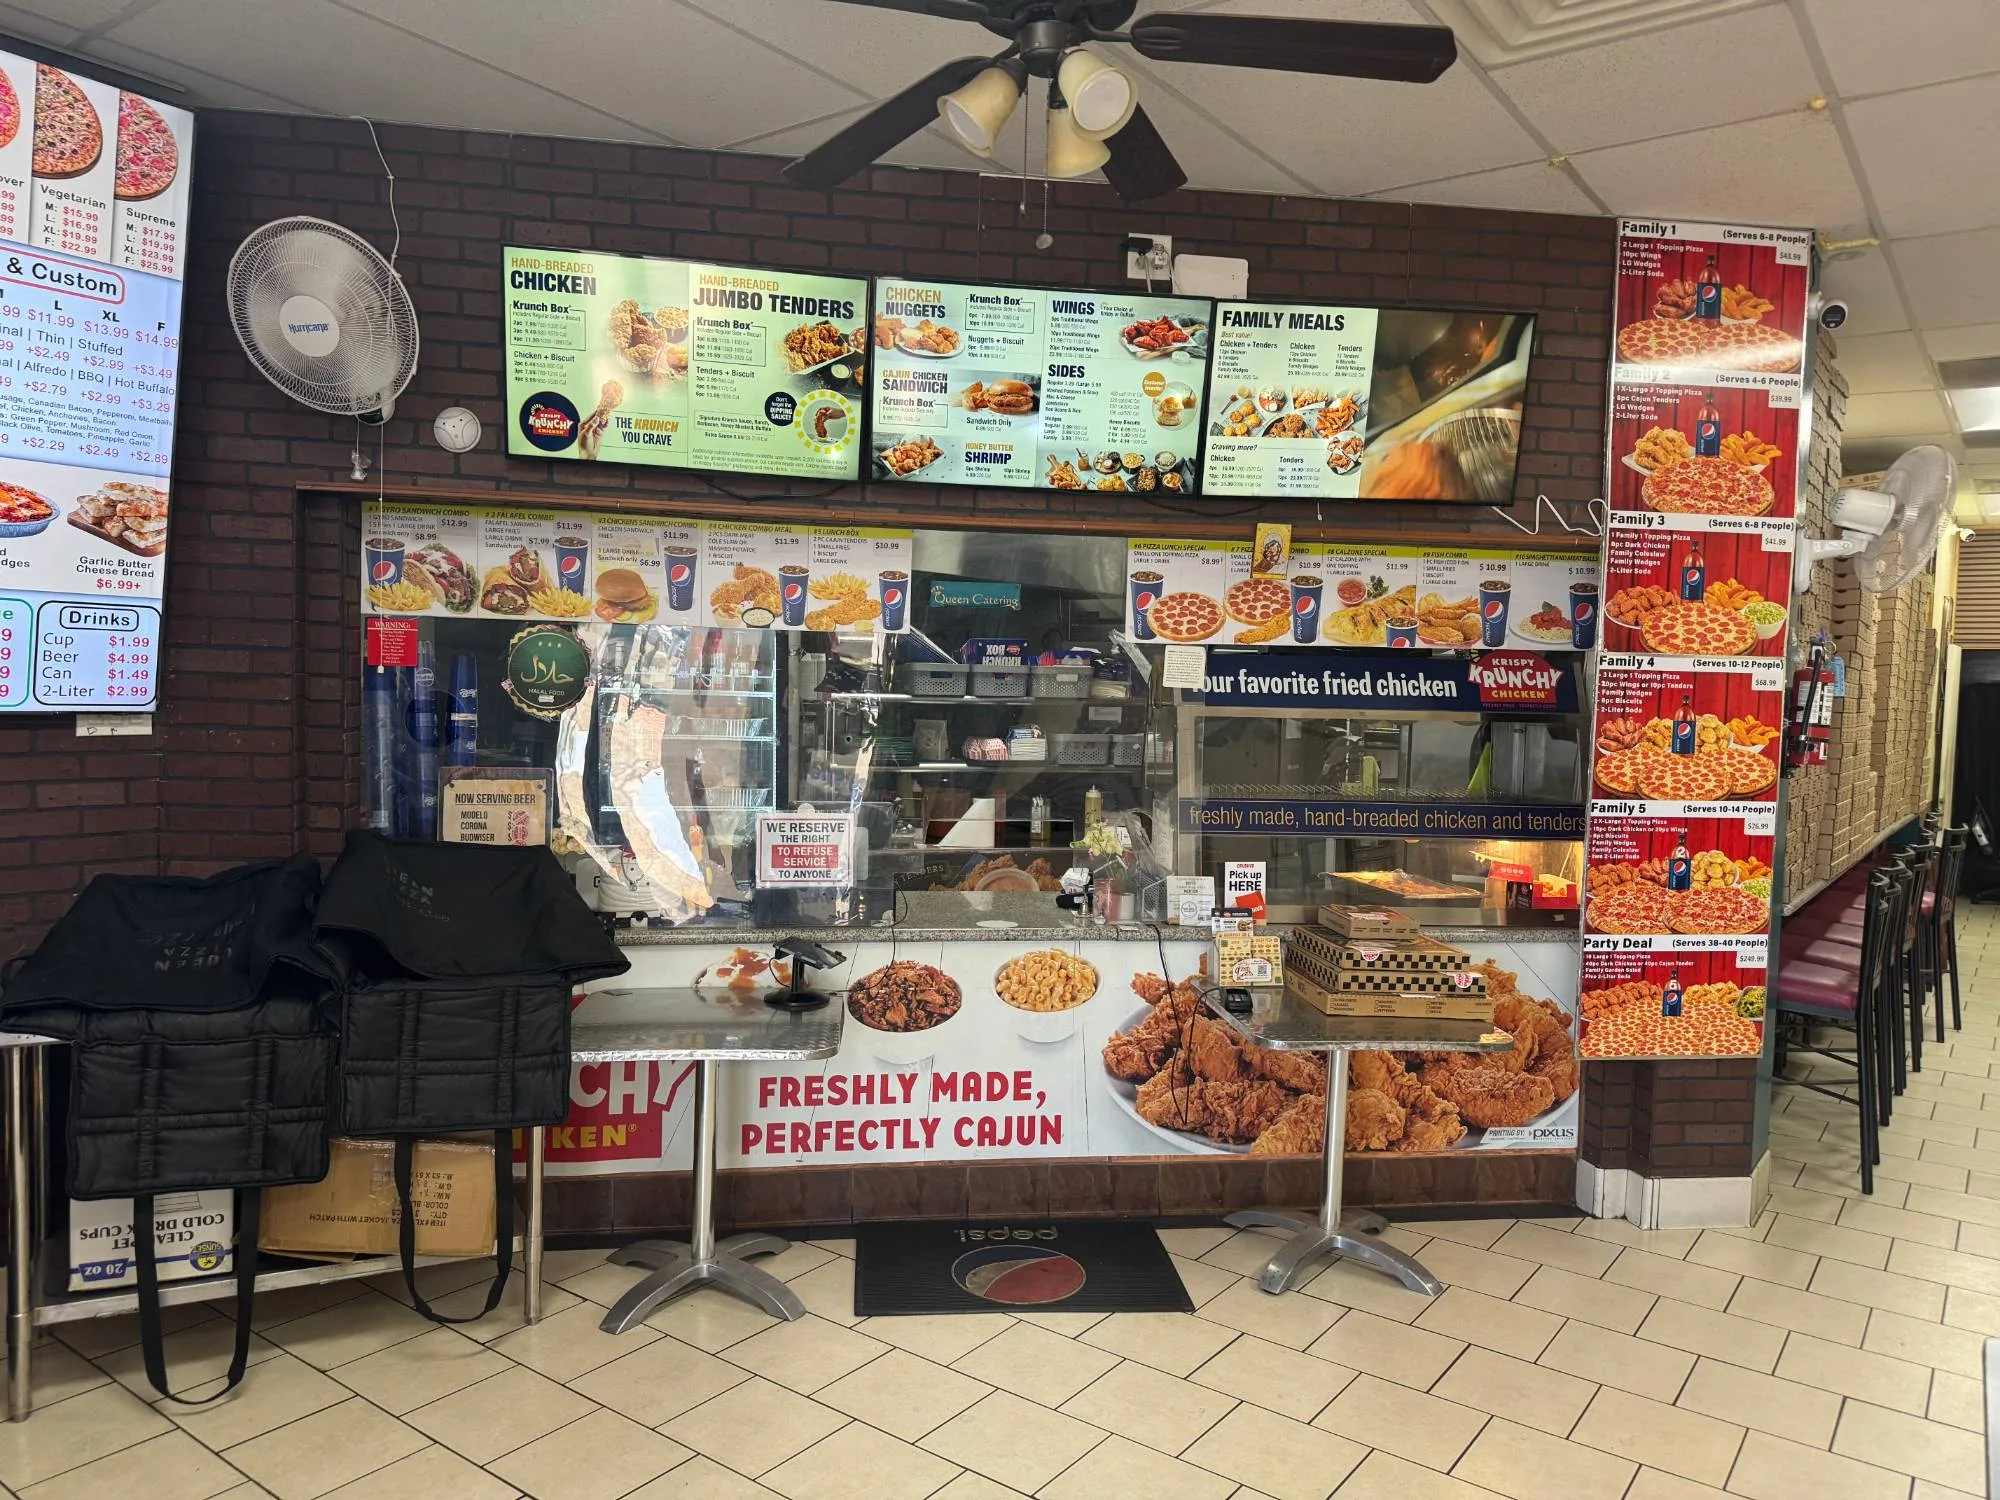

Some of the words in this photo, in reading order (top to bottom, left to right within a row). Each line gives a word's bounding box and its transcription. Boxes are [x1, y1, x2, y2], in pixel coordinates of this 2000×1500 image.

[40, 184, 106, 210] Vegetarian
[126, 208, 176, 228] Supreme
[1622, 222, 1667, 236] Family
[1672, 225, 1676, 235] 1
[511, 257, 593, 274] HAND-BREADED
[6, 257, 24, 275] &
[32, 263, 117, 295] Custom
[511, 270, 597, 295] CHICKEN
[700, 274, 779, 291] HAND-BREADED
[886, 287, 941, 303] CHICKEN
[513, 301, 547, 312] Krunch
[694, 288, 762, 310] JUMBO
[769, 294, 854, 319] TENDERS
[886, 302, 945, 318] NUGGETS
[1052, 300, 1095, 315] WINGS
[102, 310, 120, 322] XL
[1223, 311, 1284, 328] FAMILY
[1288, 313, 1345, 331] MEALS
[28, 309, 74, 328] $11.99
[84, 321, 129, 339] $13.99
[136, 331, 178, 348] $14.99
[288, 323, 330, 334] Hurricane
[37, 330, 65, 345] Thin
[78, 339, 123, 355] Stuffed
[1252, 341, 1277, 349] Tenders
[514, 351, 542, 360] Chicken
[551, 354, 575, 362] Biscuit
[883, 369, 911, 378] CAJUN
[913, 371, 947, 382] CHICKEN
[1048, 364, 1085, 378] SIDES
[24, 361, 67, 376] Alfredo
[78, 371, 104, 383] BBQ
[115, 377, 134, 389] Hot
[138, 381, 174, 396] Buffalo
[882, 379, 947, 394] SANDWICH
[616, 417, 632, 429] THE
[634, 418, 679, 432] KRUNCH
[967, 417, 997, 425] Sandwich
[999, 419, 1012, 427] Only
[622, 432, 640, 444] YOU
[642, 433, 672, 446] CRAVE
[965, 452, 1011, 464] SHRIMP
[441, 519, 468, 528] $12.99
[556, 522, 582, 530] $11.99
[1610, 513, 1654, 527] Family
[1657, 515, 1665, 525] 3
[1709, 519, 1742, 528] (Serves
[1761, 521, 1794, 531] People)
[749, 524, 773, 532] COMBO
[1766, 538, 1786, 546] $41.99
[79, 556, 114, 567] Garlic
[117, 559, 152, 569] Butter
[639, 559, 660, 567] $6.99
[76, 565, 118, 575] Cheese
[122, 567, 154, 578] Bread
[96, 578, 141, 590] $6.99+
[935, 593, 968, 605] Queen
[973, 593, 1018, 606] Catering
[69, 611, 130, 626] Drinks
[375, 621, 411, 629] WARNING:
[43, 633, 74, 647] Cup
[109, 636, 149, 647] $1.99
[986, 645, 1005, 655] BOX
[43, 650, 79, 663] Beer
[108, 653, 148, 664] $4.99
[1492, 658, 1534, 666] KRISPY
[1600, 656, 1643, 669] Family
[1647, 657, 1654, 667] 4
[42, 667, 72, 679] Can
[108, 669, 148, 680] $1.49
[1468, 664, 1562, 689] KRUNCHY
[1193, 673, 1234, 693] our
[1238, 668, 1319, 695] favorite
[1323, 671, 1372, 696] fried
[1376, 672, 1457, 698] chicken
[42, 685, 94, 697] 2-Liter
[107, 686, 147, 697] $2.99
[455, 794, 474, 803] NOW
[477, 794, 512, 804] SERVING
[514, 794, 535, 804] BEER
[461, 811, 488, 819] MODELO
[1591, 803, 1634, 815] Family
[1638, 804, 1646, 813] 5
[1190, 806, 1243, 829] freshly
[1250, 807, 1299, 829] made,
[1305, 808, 1418, 828] hand-breaded
[1424, 810, 1486, 830] chicken
[1492, 812, 1522, 830] and
[1528, 812, 1586, 831] tenders
[461, 822, 487, 830] CORONA
[767, 823, 785, 832] WE
[790, 823, 844, 832] RESERVE
[777, 847, 790, 855] TO
[794, 847, 833, 855] REFUSE
[784, 858, 826, 866] SERVICE
[793, 870, 831, 878] ANYONE
[1230, 871, 1248, 879] Pick
[1250, 871, 1262, 881] up
[1229, 881, 1261, 891] HERE
[1584, 938, 1619, 950] Party
[1623, 938, 1652, 948] Deal
[1673, 939, 1705, 947] (Serves
[759, 1072, 918, 1108] FRESHLY
[932, 1070, 1046, 1109] MADE,
[741, 1117, 941, 1155] PERFECTLY
[954, 1115, 1062, 1147] CAJUN
[1489, 1128, 1514, 1136] PRINTING
[183, 1214, 224, 1228] COLD
[309, 1214, 336, 1222] PATCH
[80, 1225, 121, 1240] CUPS
[958, 1226, 1057, 1242] pepsi
[193, 1243, 221, 1253] SUNSET
[84, 1266, 101, 1275] oz
[106, 1263, 123, 1274] 20
